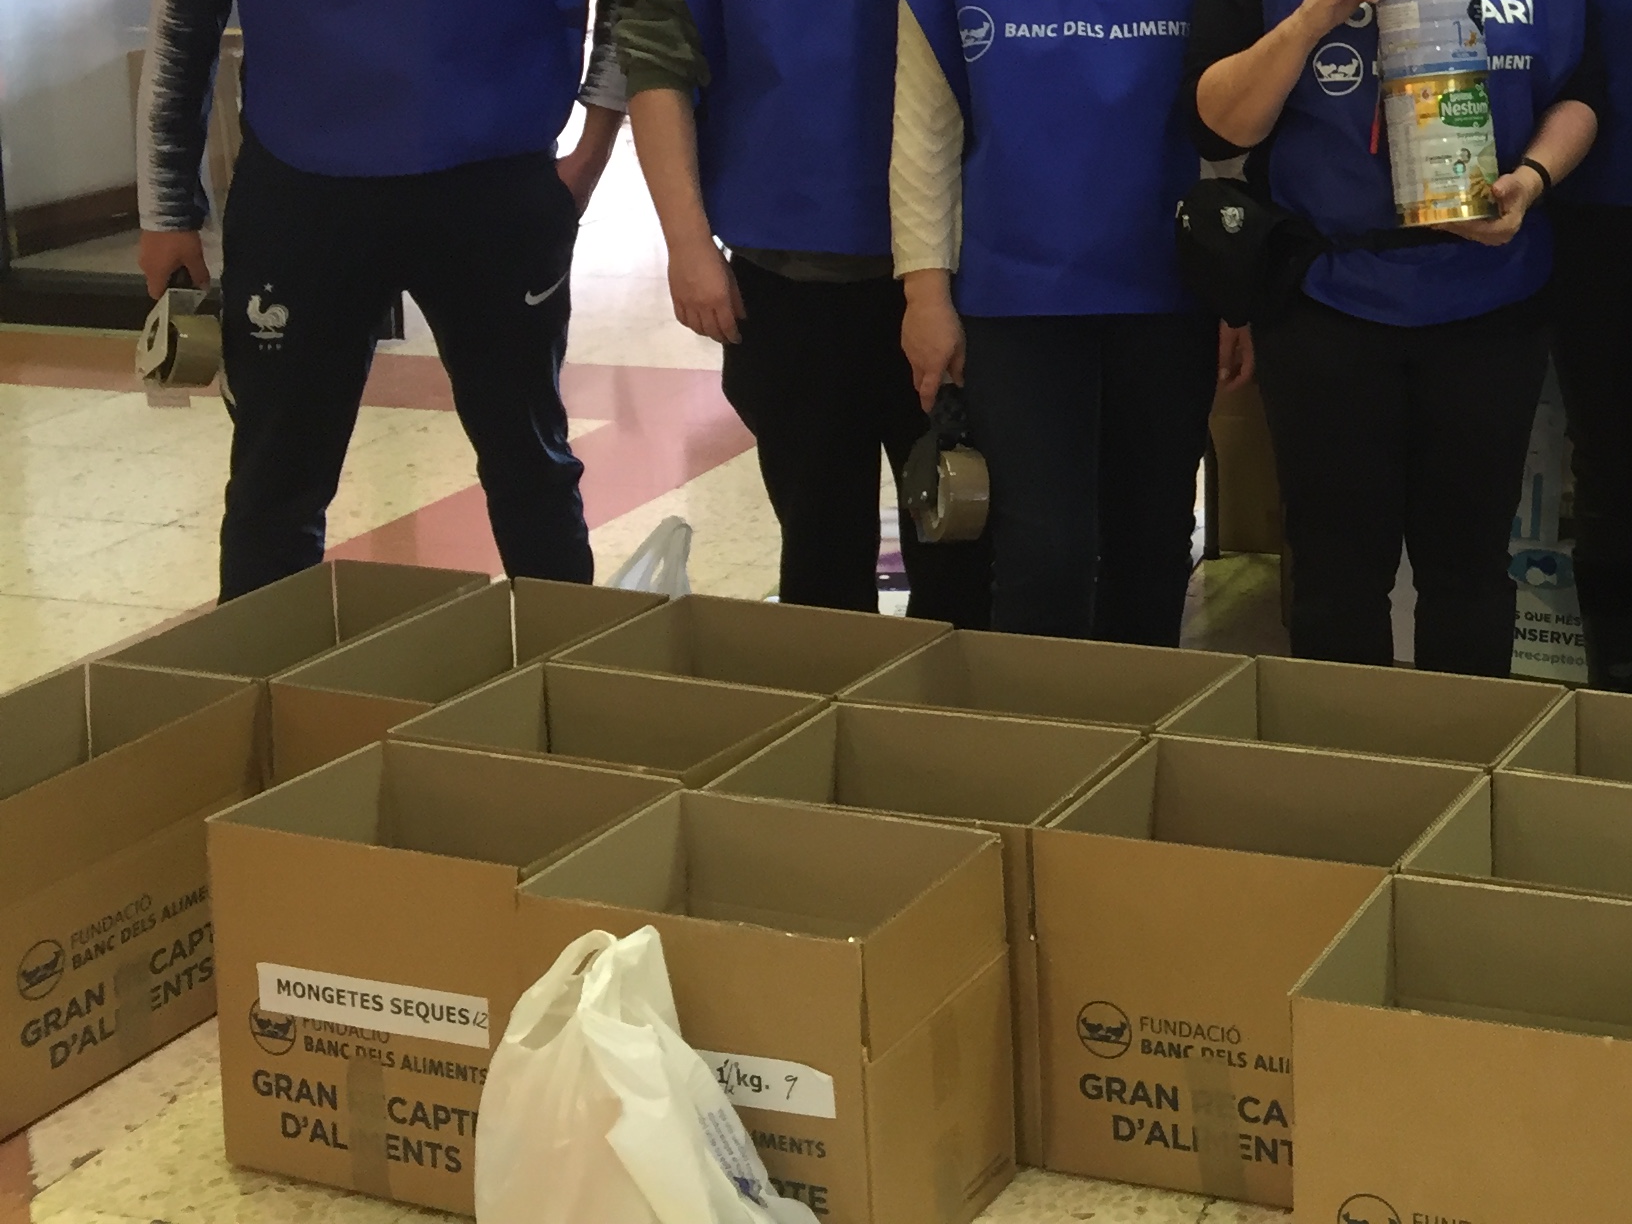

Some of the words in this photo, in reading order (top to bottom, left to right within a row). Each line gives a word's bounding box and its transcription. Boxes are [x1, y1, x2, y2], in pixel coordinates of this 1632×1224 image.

[1005, 22, 1058, 38] BANC
[1063, 21, 1104, 38] DELS
[1441, 101, 1489, 116] Nestum
[1514, 627, 1586, 648] NSERVE
[1524, 611, 1552, 624] QUE
[70, 892, 153, 949] FUNDACIÓ
[72, 935, 115, 970] BANC
[120, 915, 157, 944] DELS
[161, 885, 209, 922] ALIME
[21, 982, 105, 1048] GRAN
[149, 921, 215, 975] CAPT
[276, 978, 384, 1012] MONGETES
[390, 997, 471, 1025] SEQUES
[1139, 1016, 1241, 1045] FUNDACIÓ
[304, 1036, 350, 1060] BANC
[400, 1054, 487, 1085] ALIMENTS
[253, 1069, 338, 1111] GRAN
[1079, 1074, 1179, 1112] GRAN
